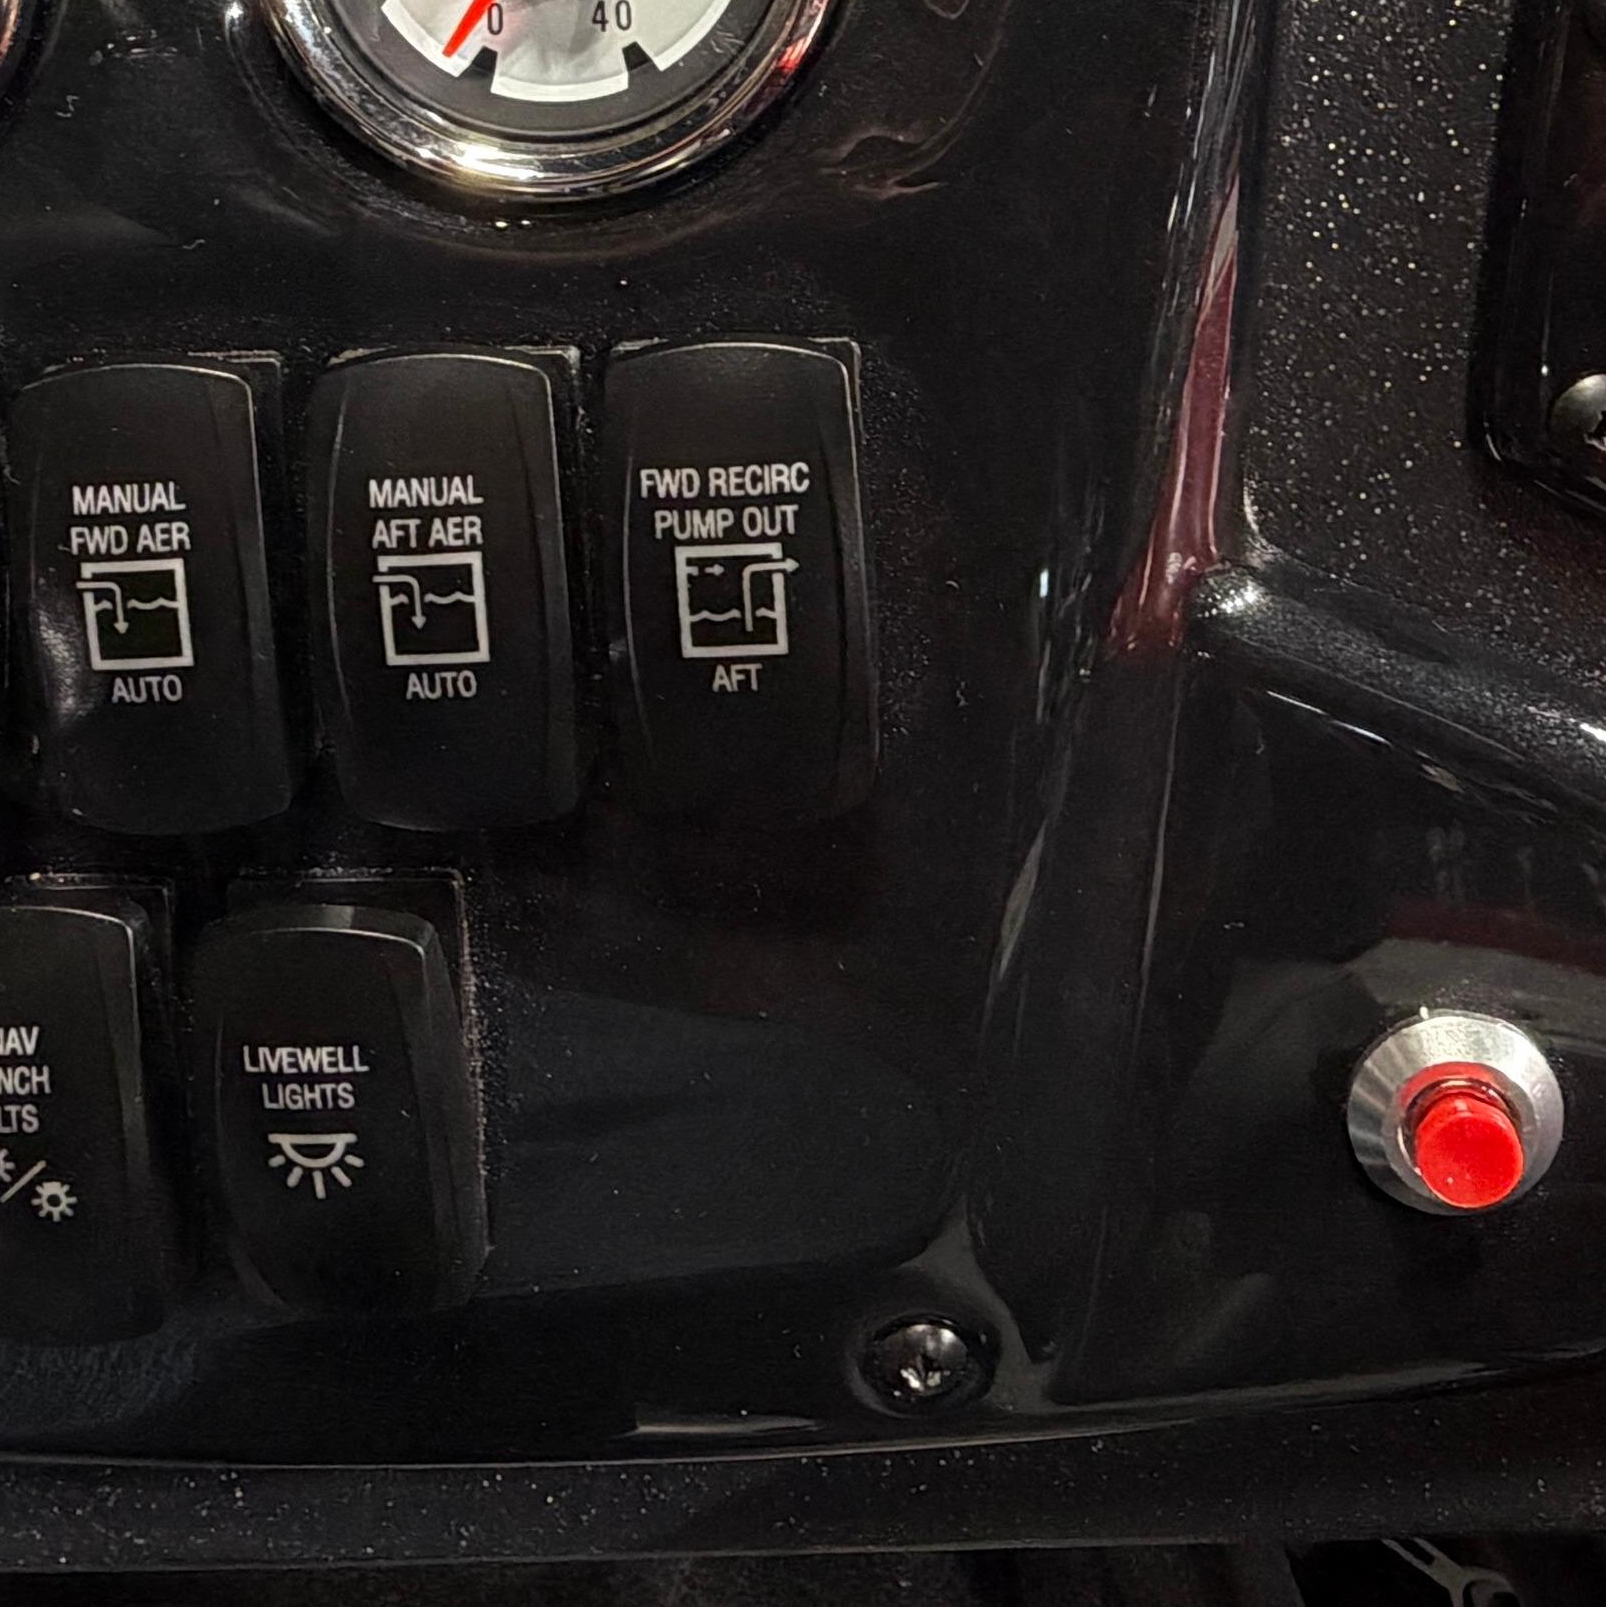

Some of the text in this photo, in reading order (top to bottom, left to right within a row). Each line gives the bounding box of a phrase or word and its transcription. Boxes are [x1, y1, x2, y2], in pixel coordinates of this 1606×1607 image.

[486, 2, 505, 38] 0
[591, 0, 631, 32] 40
[370, 475, 483, 507] MANUAL
[641, 462, 809, 498] FWD RECIRC
[73, 482, 185, 514] MANUAL
[71, 522, 190, 554] FWD AER
[373, 516, 482, 548] AFT AER
[655, 505, 798, 539] PUMP OUT
[113, 675, 182, 702] AUTO
[407, 670, 476, 699] AUTO
[713, 664, 761, 691] AFT
[244, 1046, 368, 1073] LIVEWELL
[263, 1082, 354, 1109] LIGHTS
